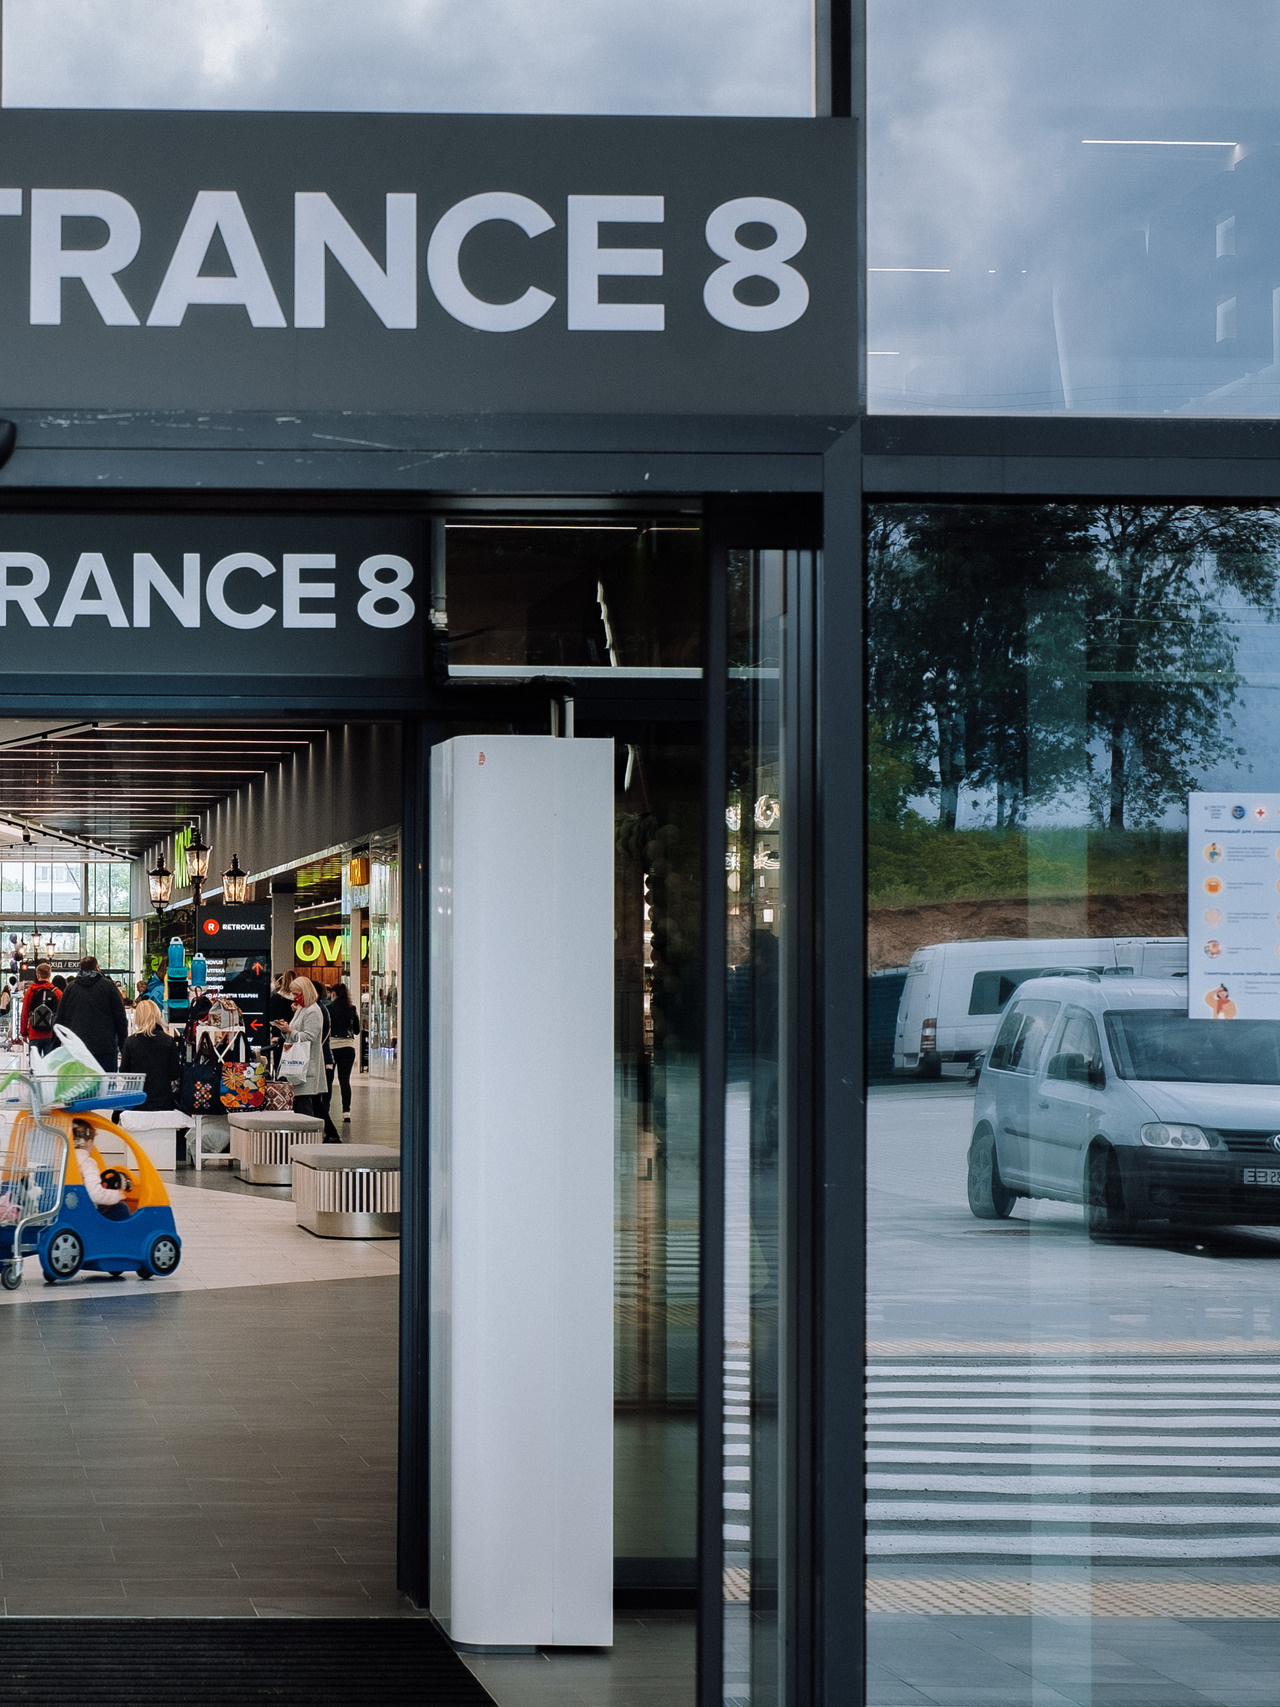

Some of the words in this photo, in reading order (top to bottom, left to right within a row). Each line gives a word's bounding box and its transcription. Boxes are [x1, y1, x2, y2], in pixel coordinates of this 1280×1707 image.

[703, 196, 810, 332] 8
[357, 554, 415, 629] 8
[222, 923, 266, 931] RETROVILLE
